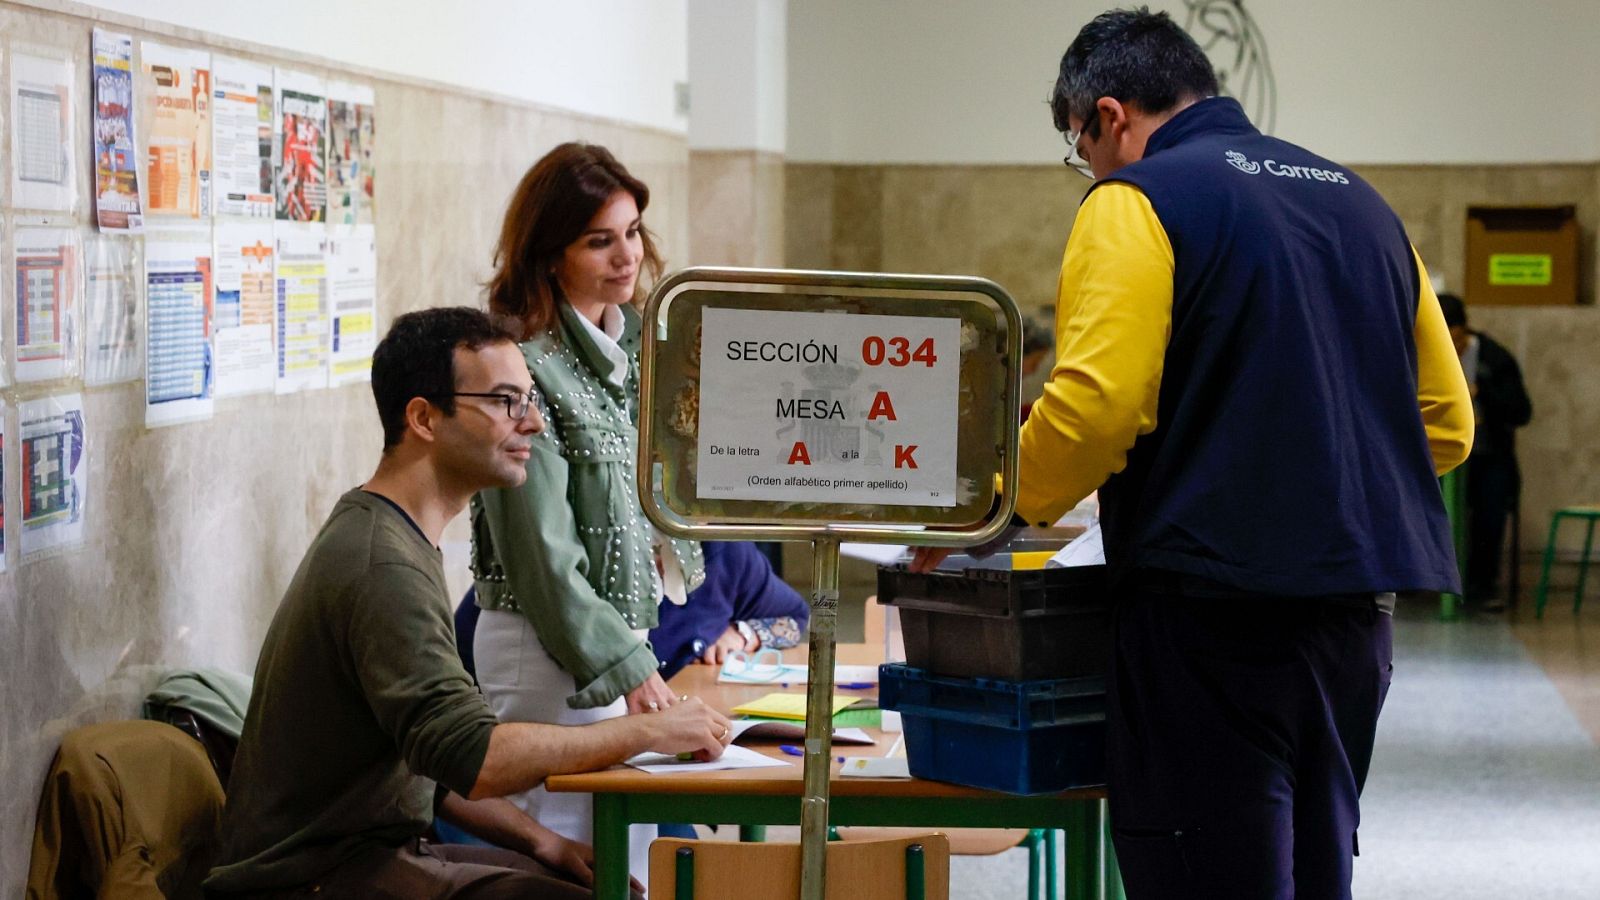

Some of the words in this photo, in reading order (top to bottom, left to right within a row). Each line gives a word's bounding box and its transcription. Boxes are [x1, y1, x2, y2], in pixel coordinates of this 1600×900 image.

[1263, 159, 1350, 185] Correos
[726, 340, 838, 364] SECCIÓN
[862, 336, 938, 368] 034
[776, 398, 845, 420] MESA
[867, 391, 897, 421] A
[710, 445, 724, 456] De
[726, 446, 736, 456] la
[738, 446, 760, 457] letra
[787, 441, 811, 466] A
[841, 452, 849, 460] a
[850, 450, 860, 460] la
[894, 445, 919, 469] K
[747, 475, 781, 488] (Orden
[784, 476, 831, 488] alfabético
[833, 479, 864, 491] primer
[866, 479, 908, 491] apellido)
